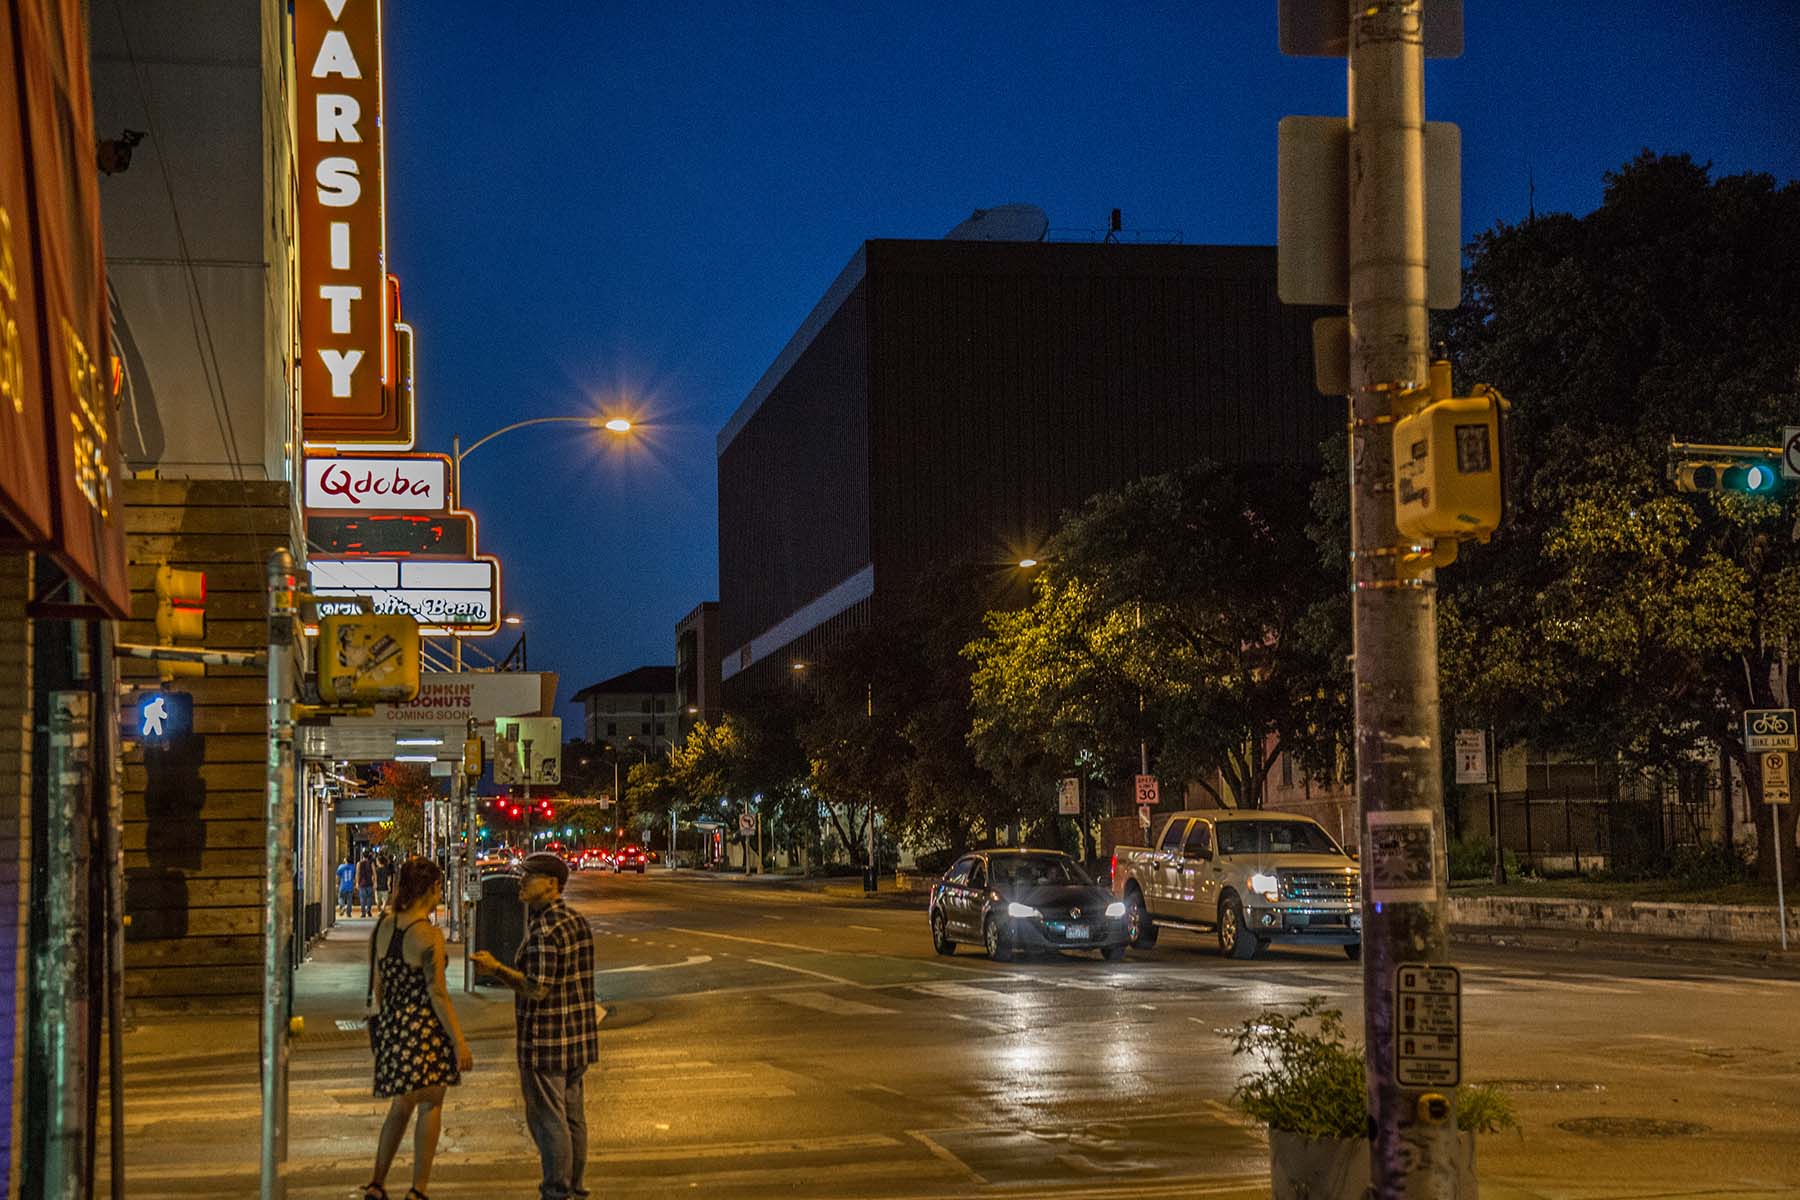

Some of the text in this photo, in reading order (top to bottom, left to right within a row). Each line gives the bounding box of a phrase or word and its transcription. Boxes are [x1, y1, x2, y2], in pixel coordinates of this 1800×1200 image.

[320, 463, 431, 505] Qdoba
[422, 599, 487, 619] Bean
[421, 684, 474, 696] UNKIN'
[410, 696, 472, 708] DONUTS
[387, 710, 434, 721] COMING
[1771, 737, 1790, 746] LANE
[1139, 789, 1156, 800] 30
